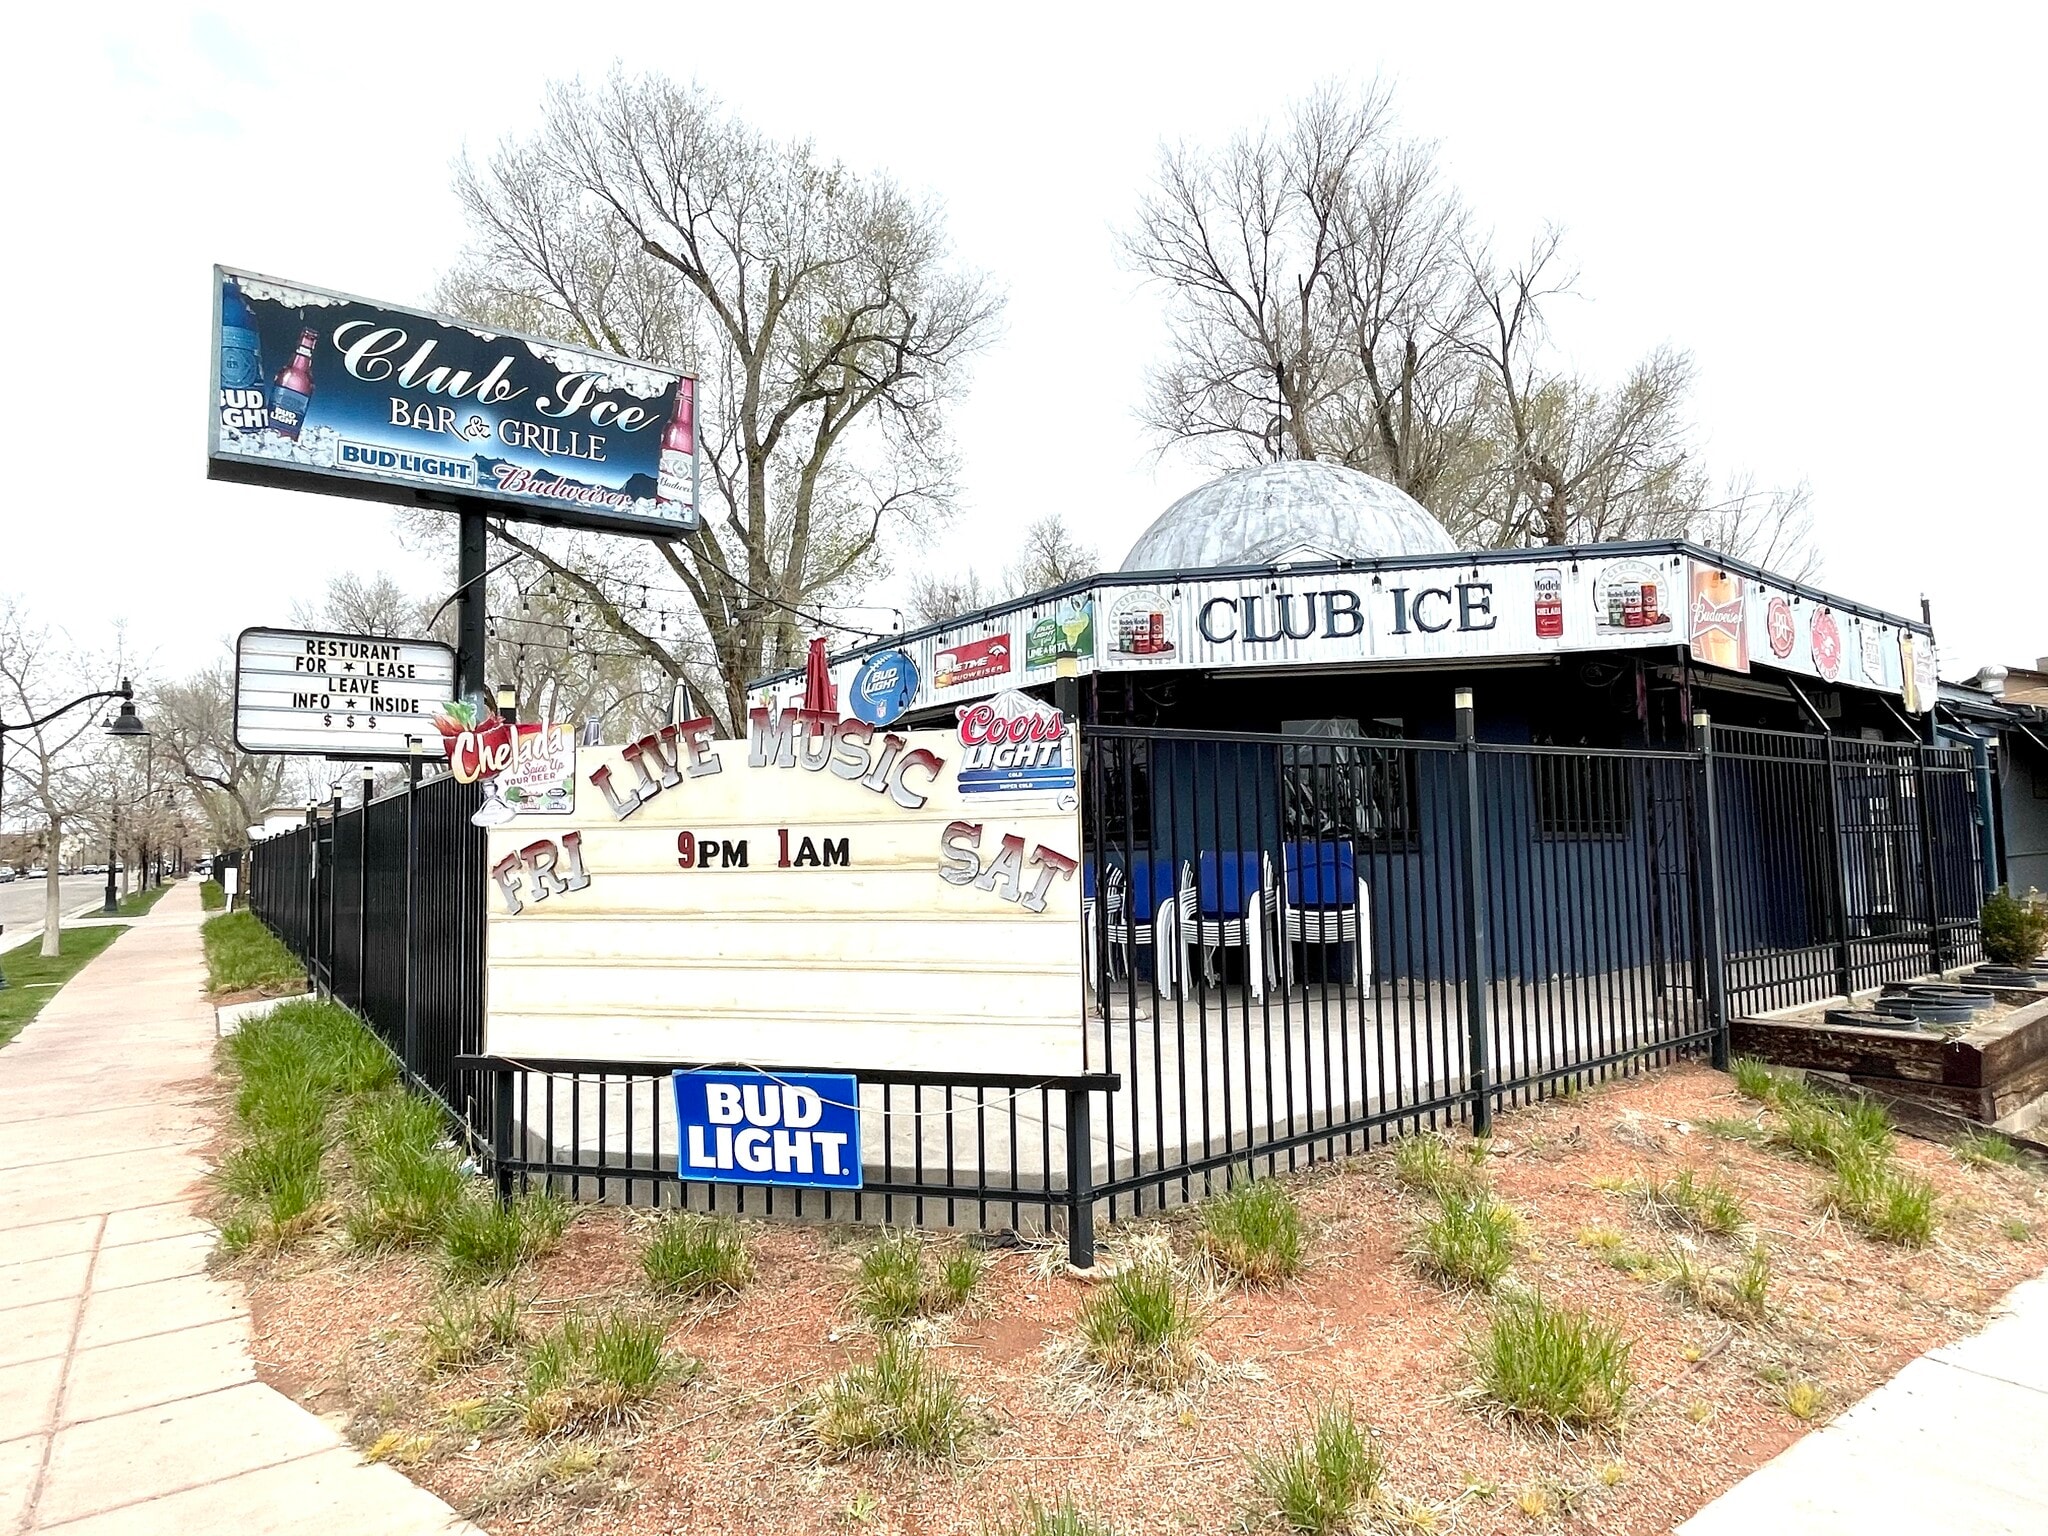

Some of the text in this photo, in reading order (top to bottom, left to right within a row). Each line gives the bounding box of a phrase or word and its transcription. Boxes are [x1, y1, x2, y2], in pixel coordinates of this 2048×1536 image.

[332, 319, 662, 432] Club Ice
[270, 410, 299, 426] LIGHT
[275, 406, 297, 419] BUD
[389, 396, 607, 463] BAR & GRILLE
[342, 445, 471, 480] BUD LIGHT
[492, 463, 634, 507] Budweiser
[1198, 582, 1498, 644] CLUB ICE
[296, 656, 416, 679] FOR LEASE
[306, 639, 401, 661] RESTURANT
[328, 677, 379, 694] LEAVE
[865, 676, 899, 694] LIGHT
[872, 667, 897, 683] BUD
[293, 693, 419, 713] INFO INSIDE
[323, 713, 377, 730] $ $ $
[959, 704, 1065, 746] Coors
[451, 718, 564, 784] Chelada
[550, 758, 565, 773] Up
[588, 706, 948, 822] LIVE MUSIC
[965, 741, 1062, 769] LIGHT
[504, 776, 529, 786] YOUR
[531, 772, 556, 783] BEER
[676, 827, 851, 869] 9PM 1AM
[491, 829, 592, 916] FRI
[938, 820, 1080, 914] SAT
[705, 1082, 823, 1129] BUD
[687, 1124, 848, 1176] LIGHT
